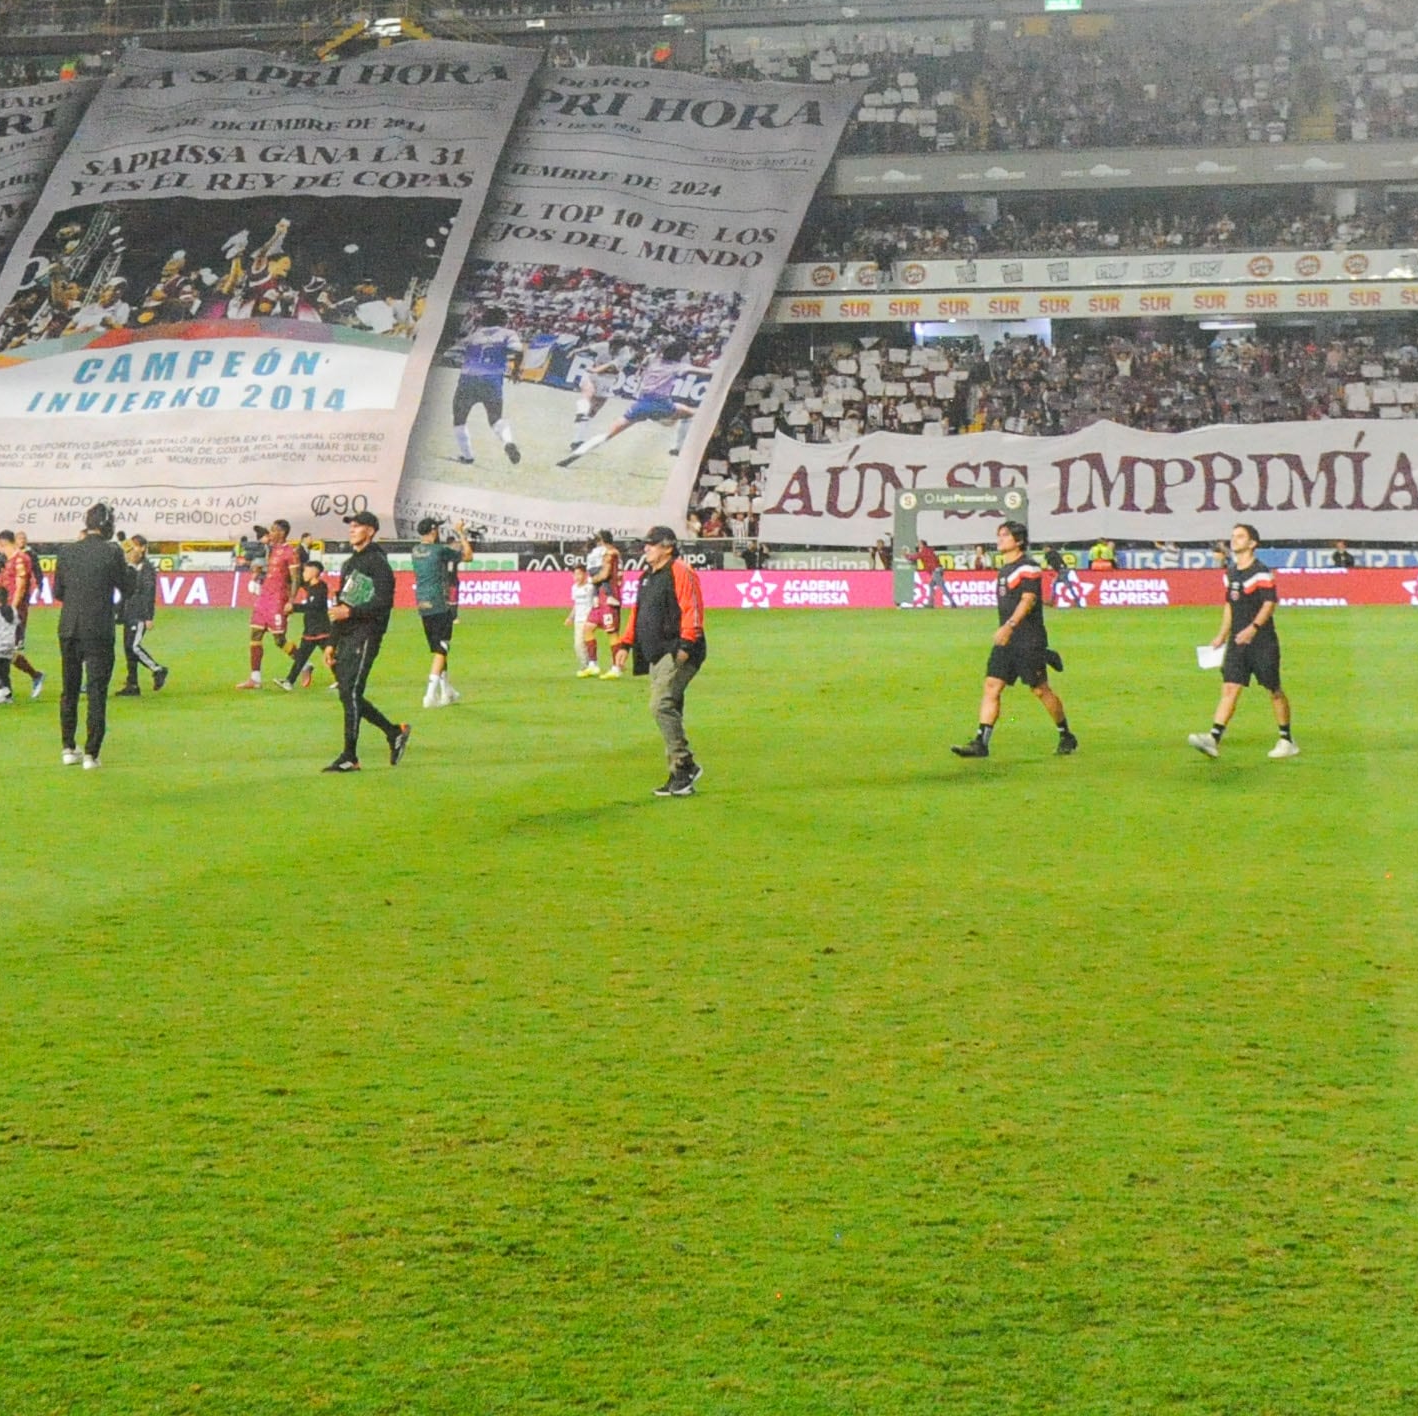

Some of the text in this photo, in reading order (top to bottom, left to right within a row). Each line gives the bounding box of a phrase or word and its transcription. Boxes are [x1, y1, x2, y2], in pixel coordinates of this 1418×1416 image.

[190, 65, 343, 89] SAPRI
[354, 62, 512, 85] HORA
[637, 95, 825, 131] HORA
[209, 118, 340, 132] DICIEMBRE
[346, 117, 378, 130] DE
[81, 144, 247, 177] SAPRISSA
[259, 144, 361, 166] GANA
[373, 144, 419, 164] LA
[430, 146, 468, 166] 31
[69, 170, 476, 197] Y ES EL REY DE COPAS
[621, 173, 662, 192] DE
[667, 180, 723, 198] 2024
[540, 203, 605, 224] TOP
[612, 208, 644, 230] 10
[650, 218, 700, 237] DE
[712, 226, 778, 247] LOS
[561, 230, 765, 269] DEL MUNDO
[790, 304, 822, 318] SUR
[839, 302, 871, 317] SUR
[888, 301, 921, 316] SUR
[938, 300, 970, 316] SUR
[989, 300, 1020, 315] SUR
[1038, 298, 1071, 314] SUR
[1088, 297, 1121, 313] SUR
[1139, 296, 1171, 312] SUR
[1194, 294, 1226, 309] SUR
[1245, 293, 1278, 309] SUR
[1296, 292, 1329, 307] SUR
[1348, 291, 1381, 306] SUR
[72, 347, 322, 385] CAMPEÓN
[25, 384, 347, 415] INVIERNO 2014
[299, 441, 341, 451] SUMAR
[763, 444, 929, 520] AÚN
[181, 496, 201, 509] LA
[206, 496, 221, 509] 31
[226, 493, 260, 510] AÚN
[15, 509, 258, 527] SE PERIÓDICOS!
[524, 519, 630, 538] CONSIDERDO
[458, 580, 522, 593] ACADEMIA
[782, 581, 850, 593] ACADEMIA
[1099, 579, 1170, 592] ACADEMIA
[458, 593, 521, 606] SAPRISSA
[782, 593, 849, 606] SAPRISSA
[1099, 592, 1170, 606] SAPRISSA
